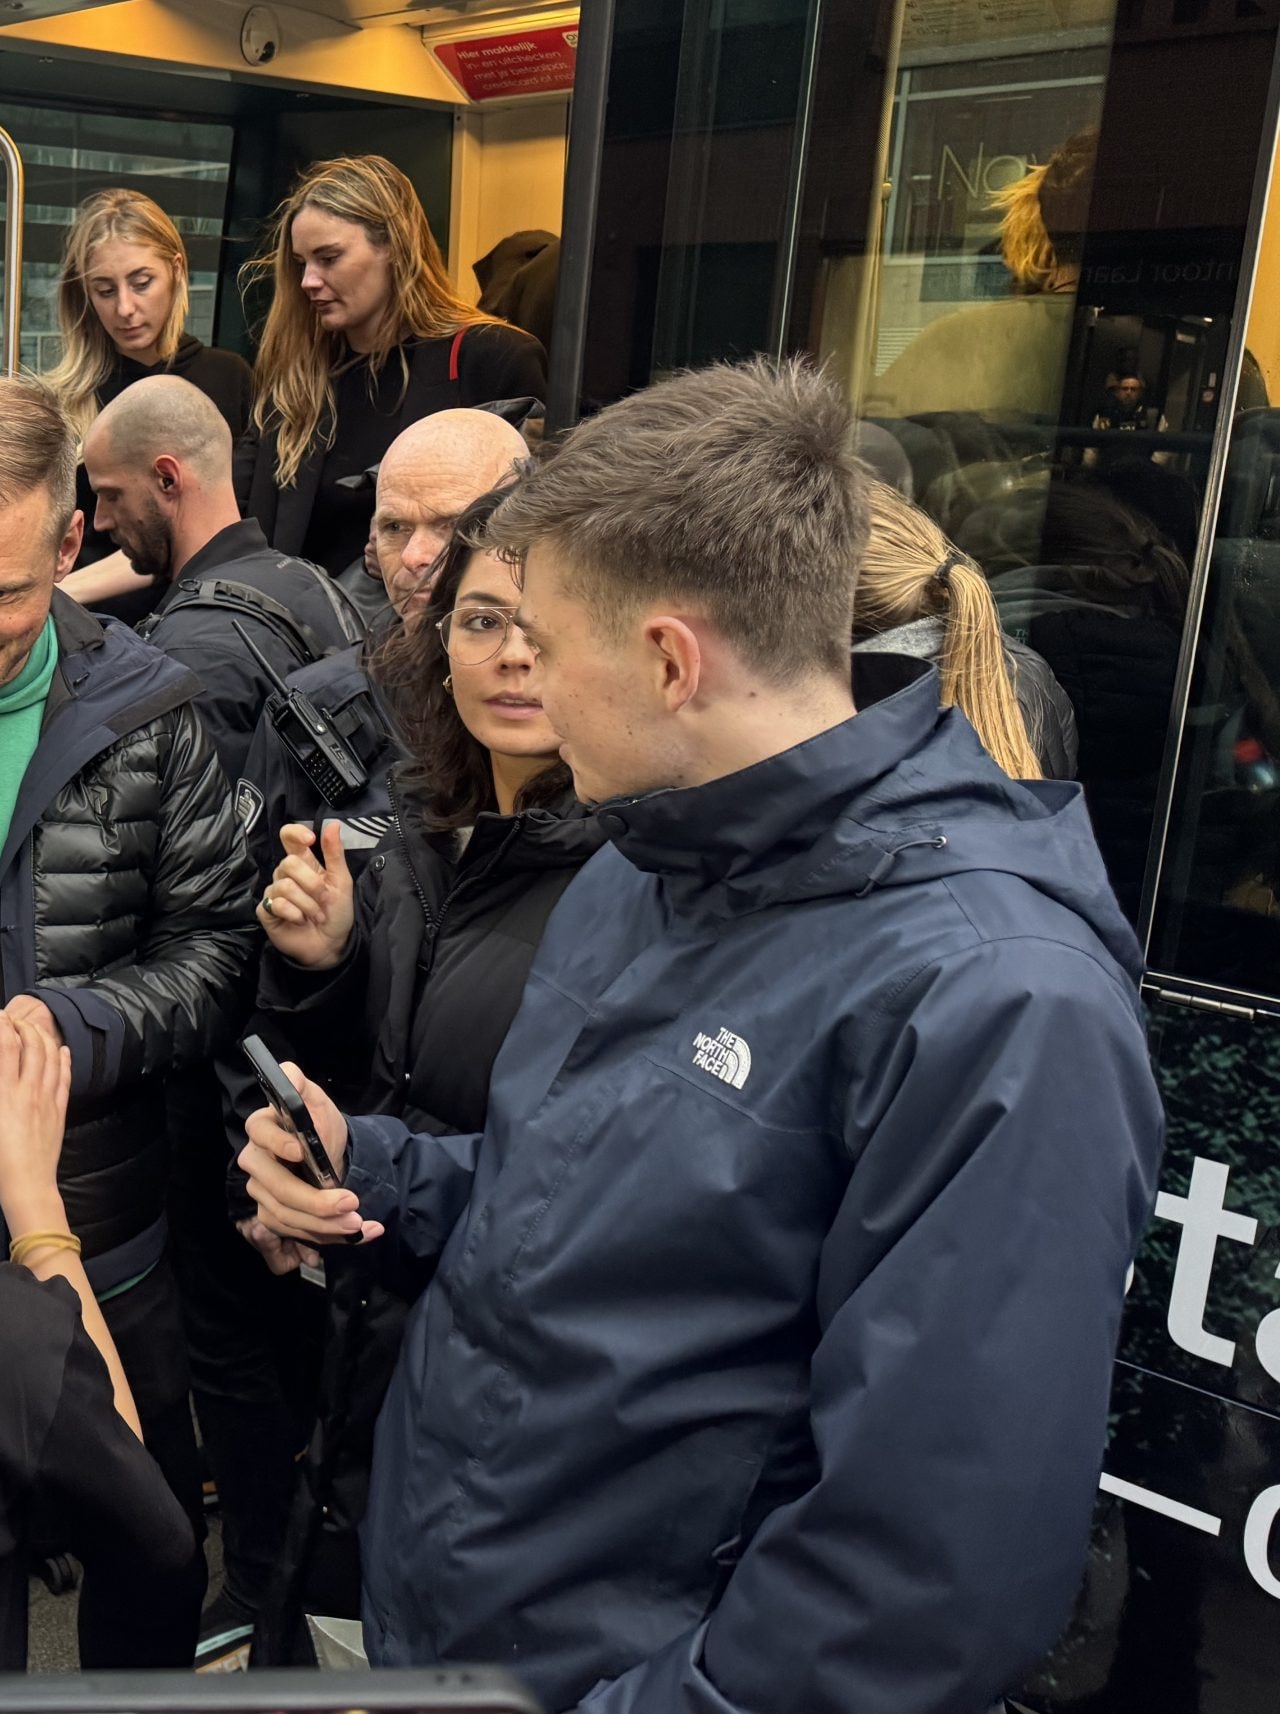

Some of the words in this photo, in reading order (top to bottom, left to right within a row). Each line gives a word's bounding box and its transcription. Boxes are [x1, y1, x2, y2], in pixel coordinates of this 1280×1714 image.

[457, 50, 480, 60] Hier
[481, 41, 538, 56] makkelijk
[500, 50, 561, 65] uitchecken
[692, 1031, 730, 1063] NORTH
[716, 1026, 737, 1048] THE
[692, 1049, 723, 1076] FACE
